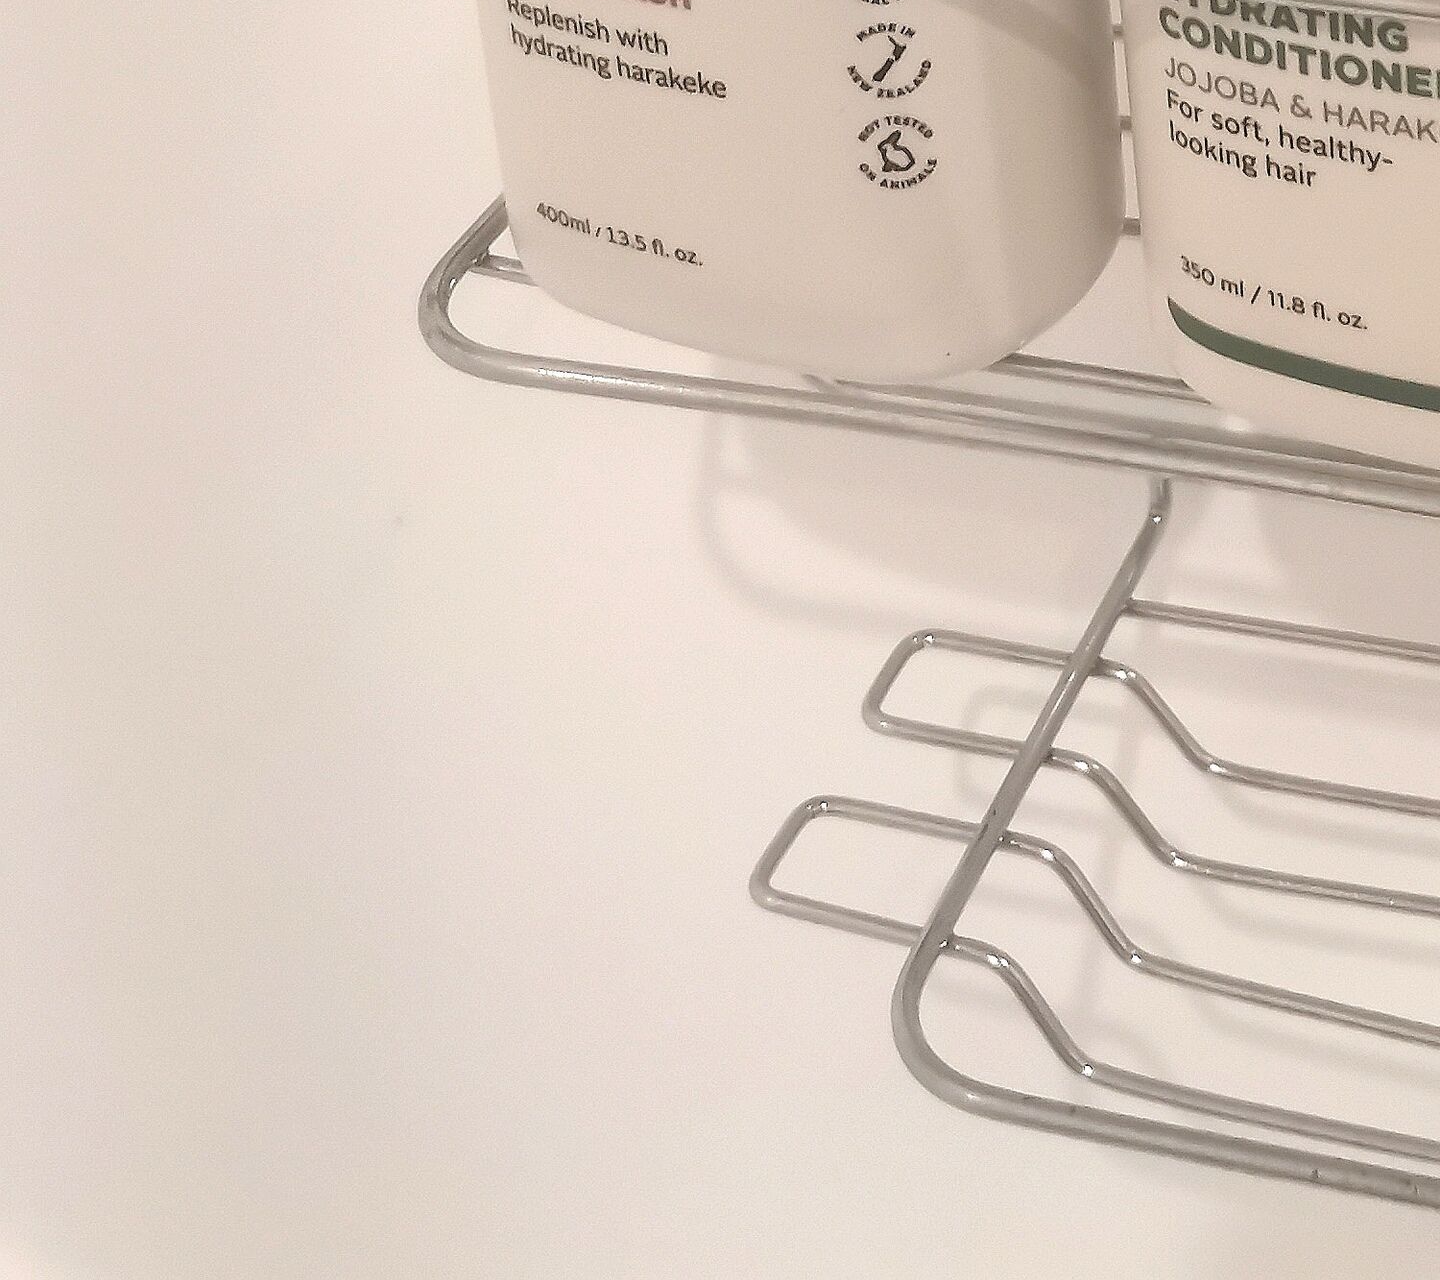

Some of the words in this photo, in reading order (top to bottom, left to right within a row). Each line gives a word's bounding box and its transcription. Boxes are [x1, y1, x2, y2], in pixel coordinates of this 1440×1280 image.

[510, 22, 612, 80] hydrating
[616, 55, 728, 99] harakeke
[616, 27, 668, 56] with
[856, 22, 897, 42] MADE
[900, 25, 916, 39] IN
[847, 64, 874, 92] NEW
[876, 59, 932, 99] ZEALAND
[1163, 57, 1280, 113] JOJOBA
[1289, 93, 1313, 120] &
[858, 119, 880, 142] NOT
[883, 115, 933, 139] TESTED
[1166, 88, 1203, 122] For
[1211, 112, 1271, 148] soft,
[1279, 124, 1393, 173] healthy-
[1169, 119, 1257, 178] looking
[1265, 153, 1317, 187] hair
[859, 162, 877, 181] ON
[879, 159, 937, 189] ANIMALS
[536, 202, 591, 234] 400ml
[606, 226, 647, 252] 13.5
[651, 237, 670, 258] fl.
[674, 247, 703, 266] oz.
[1181, 255, 1215, 286] 350
[1220, 278, 1244, 298] ml
[1251, 286, 1261, 304] /
[1267, 289, 1305, 315] 11.8
[1312, 301, 1331, 322] fl.
[1337, 311, 1368, 330] oz.
